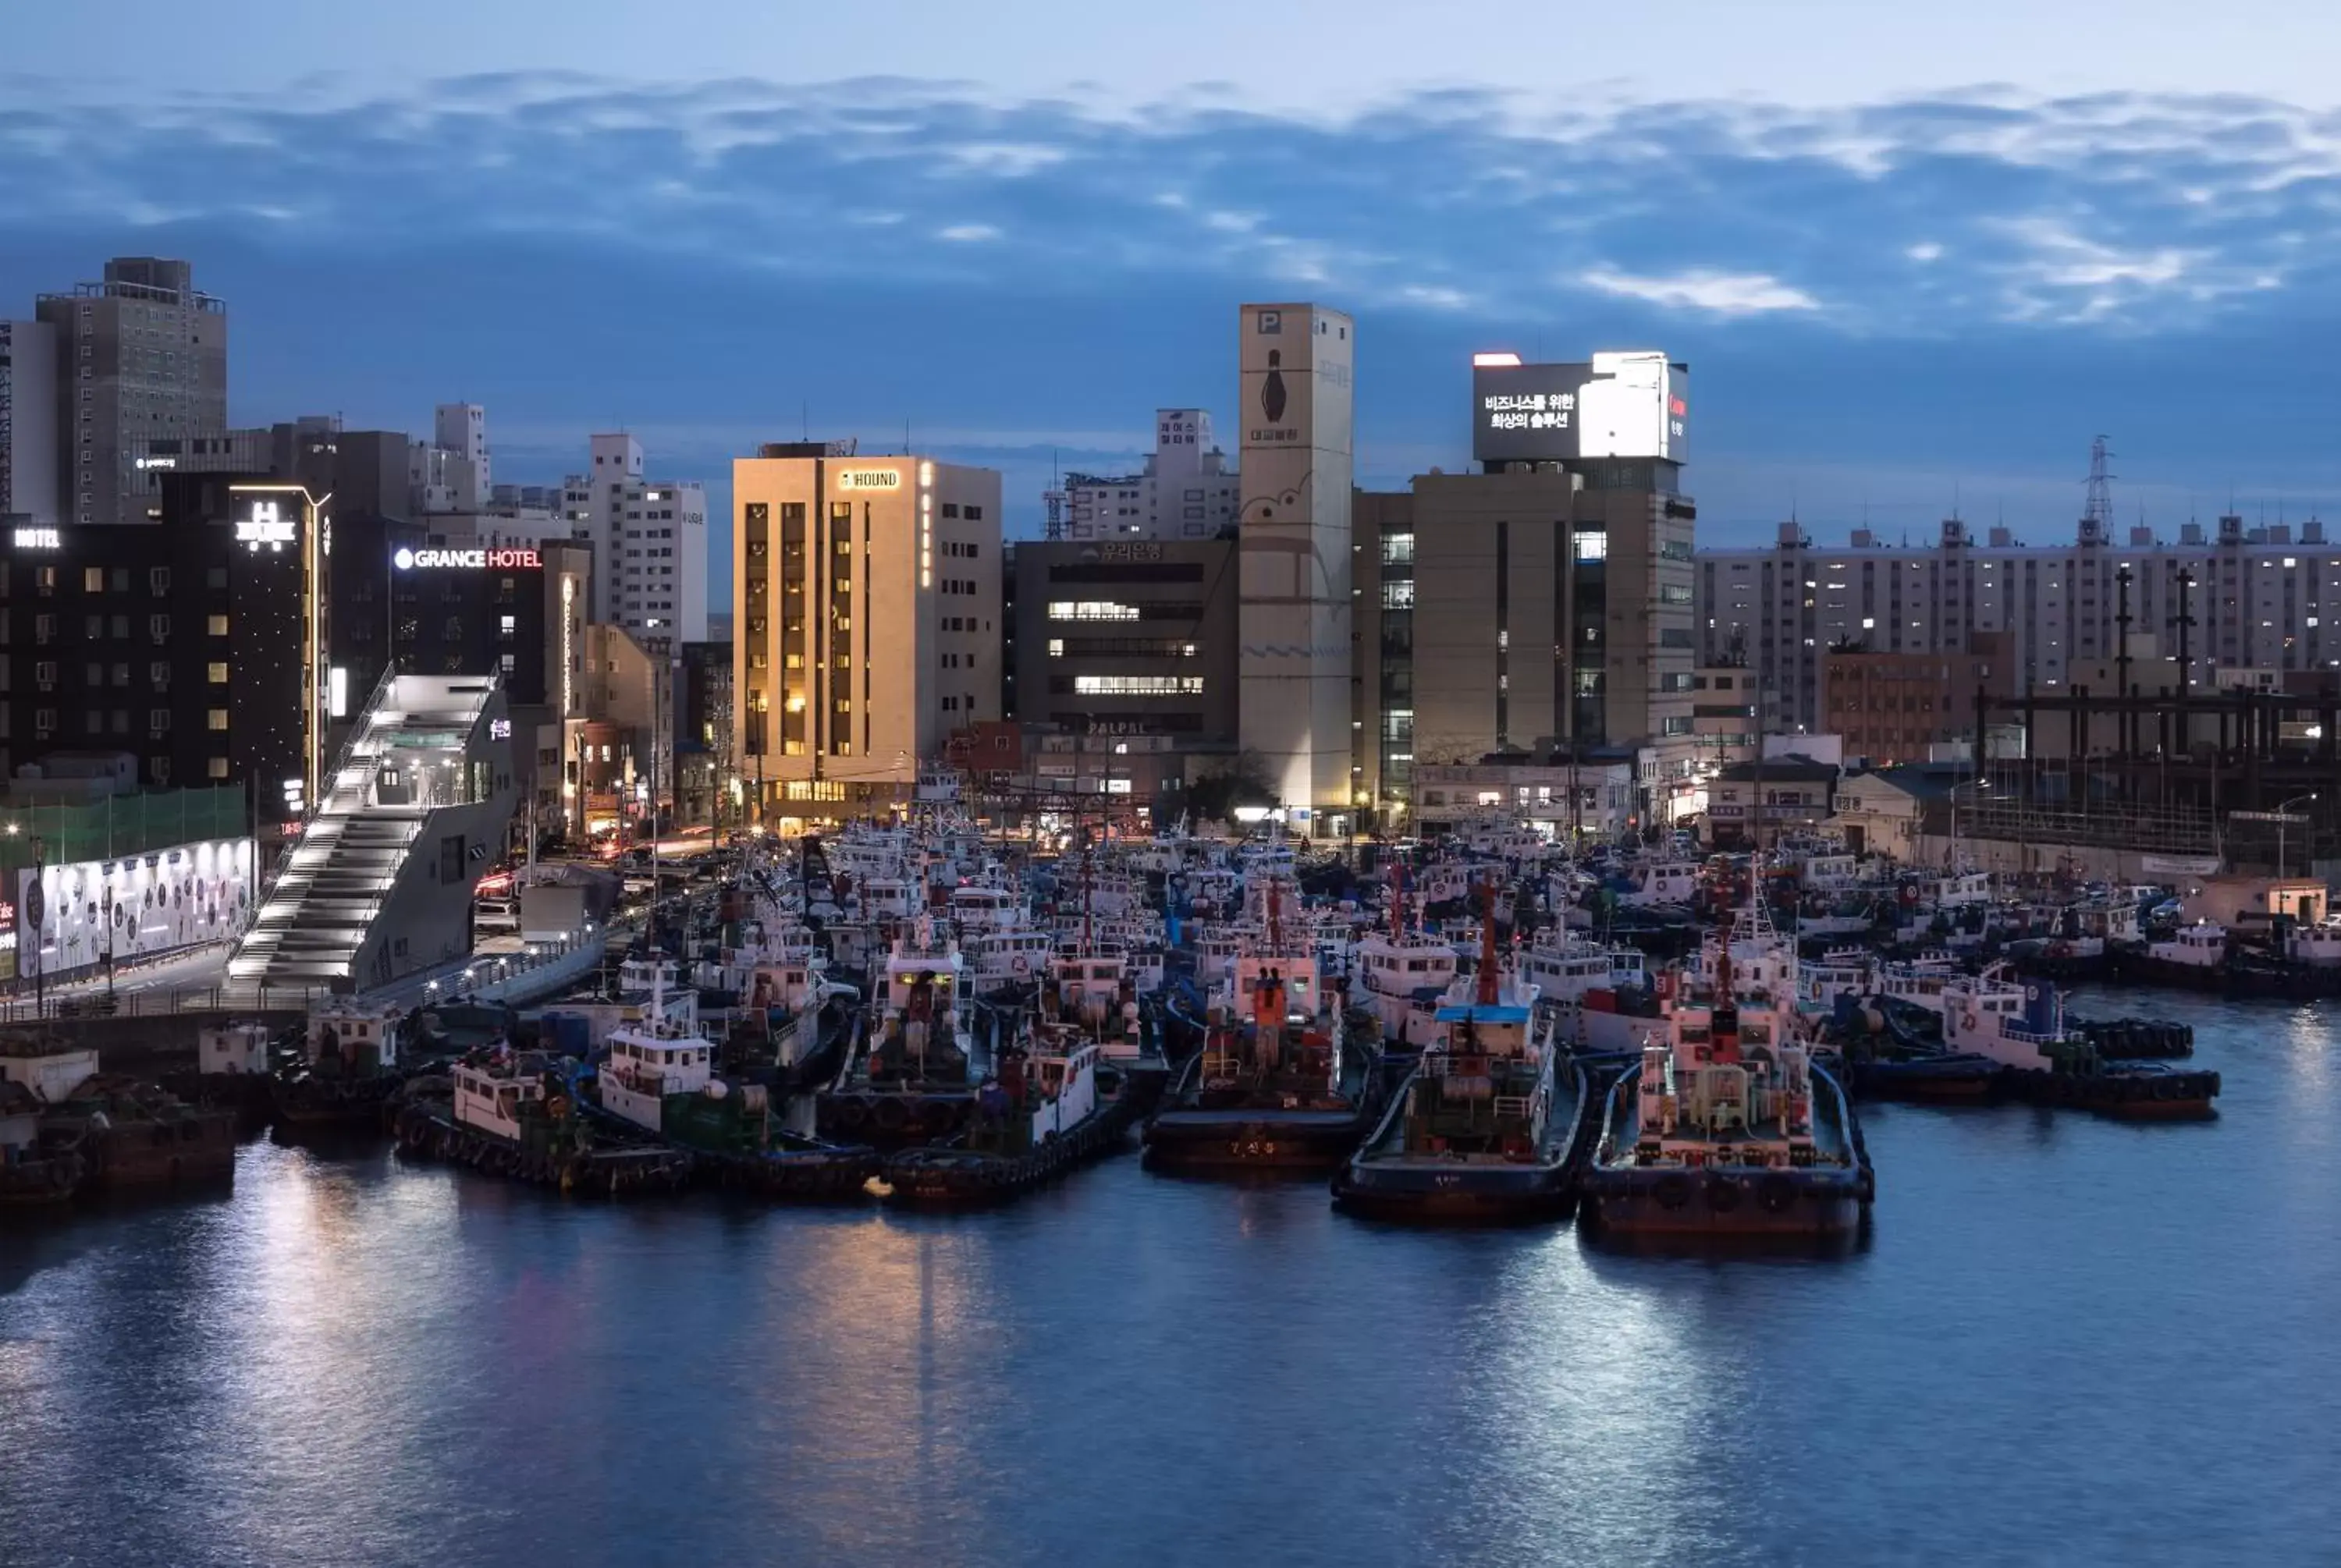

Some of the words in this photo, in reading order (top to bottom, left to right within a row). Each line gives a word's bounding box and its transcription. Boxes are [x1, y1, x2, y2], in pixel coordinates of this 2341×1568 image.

[1260, 313, 1279, 332] P
[1485, 395, 1545, 411] 비즈니스를
[1549, 393, 1575, 410] 위한
[1491, 413, 1528, 429] 최상의
[1530, 412, 1568, 428] 솔루션
[854, 472, 897, 486] HOUND
[15, 529, 60, 548] HOTEL
[414, 550, 486, 568] GRANCE
[488, 551, 542, 567] HOTEL
[1103, 541, 1161, 562] 우리은행
